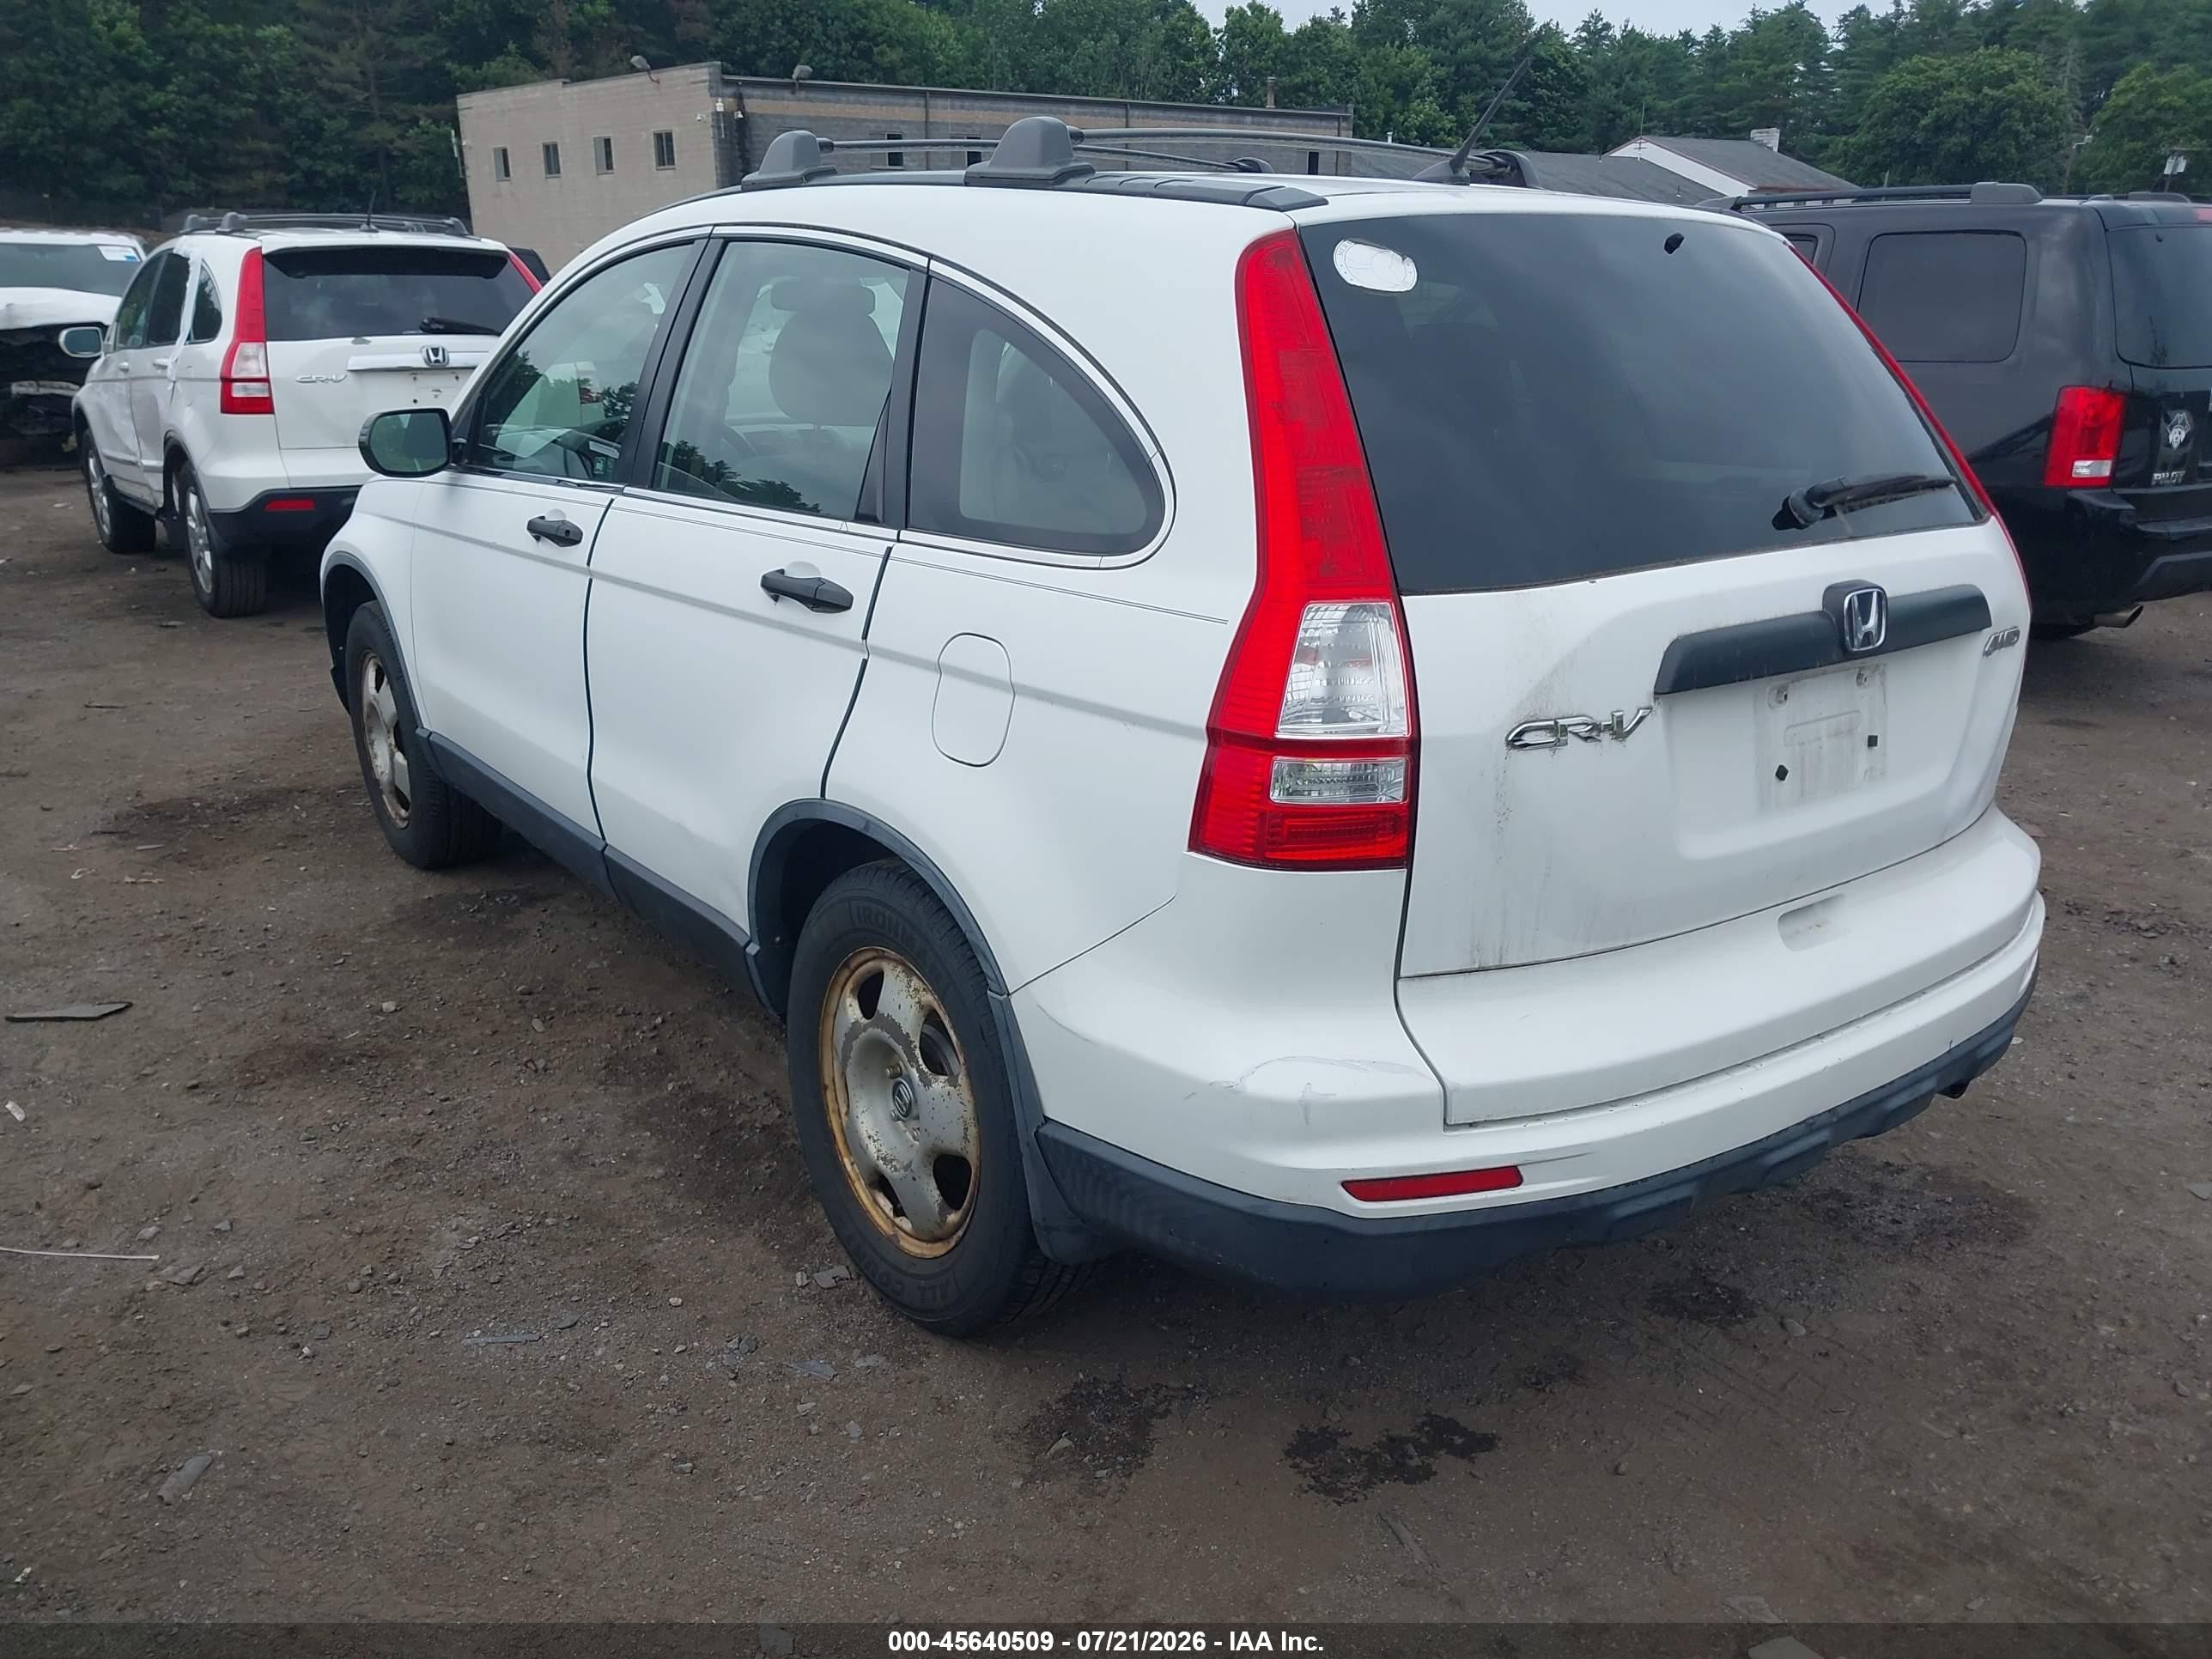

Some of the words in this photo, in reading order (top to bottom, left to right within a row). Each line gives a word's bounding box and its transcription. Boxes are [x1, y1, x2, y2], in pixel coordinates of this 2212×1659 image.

[295, 374, 348, 385] CR-V
[2151, 471, 2186, 485] PILOT
[1505, 707, 1653, 750] CR-V
